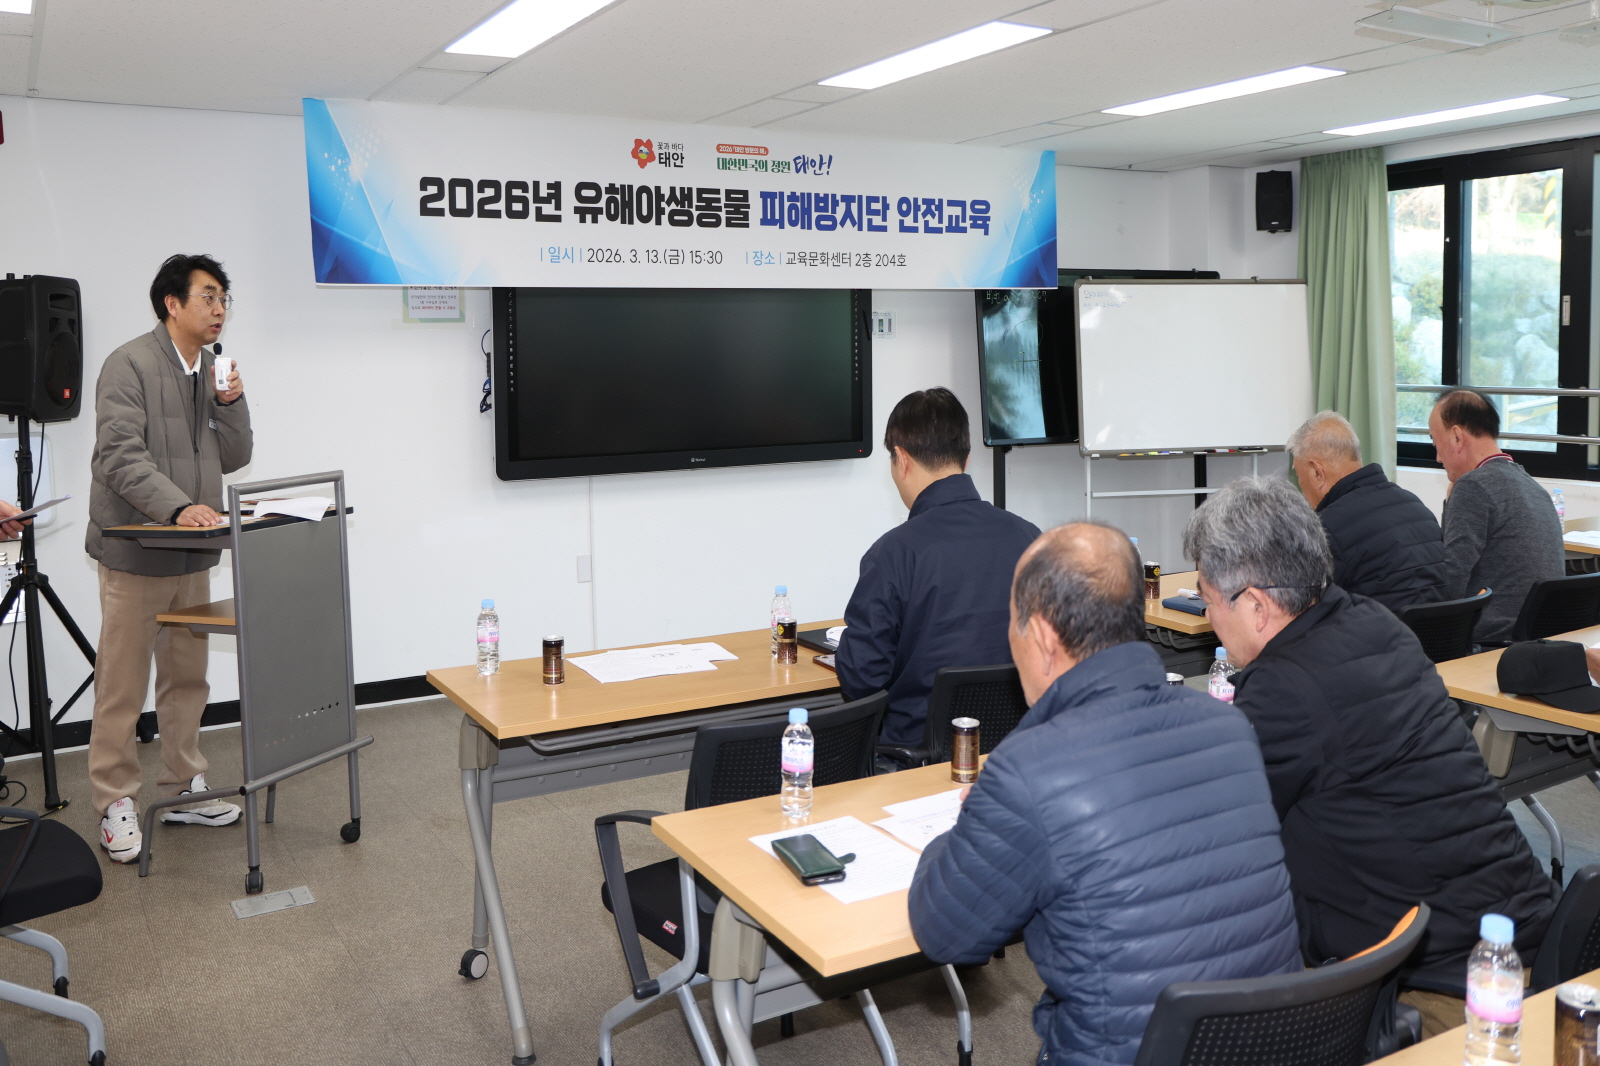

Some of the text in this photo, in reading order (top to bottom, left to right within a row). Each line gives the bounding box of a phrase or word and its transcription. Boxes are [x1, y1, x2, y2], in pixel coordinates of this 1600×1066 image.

[657, 141, 684, 152] 꽃과 바다
[658, 152, 685, 169] 태안
[716, 154, 833, 176] 대한민국의 정원 태안!
[419, 176, 992, 236] 2026년 유해야생동물 피해방지단 안전교육
[547, 246, 723, 265] 일시 2026. 3. 13.(금) 15:30
[752, 250, 907, 268] 장소 교육문화센터 2층 204호
